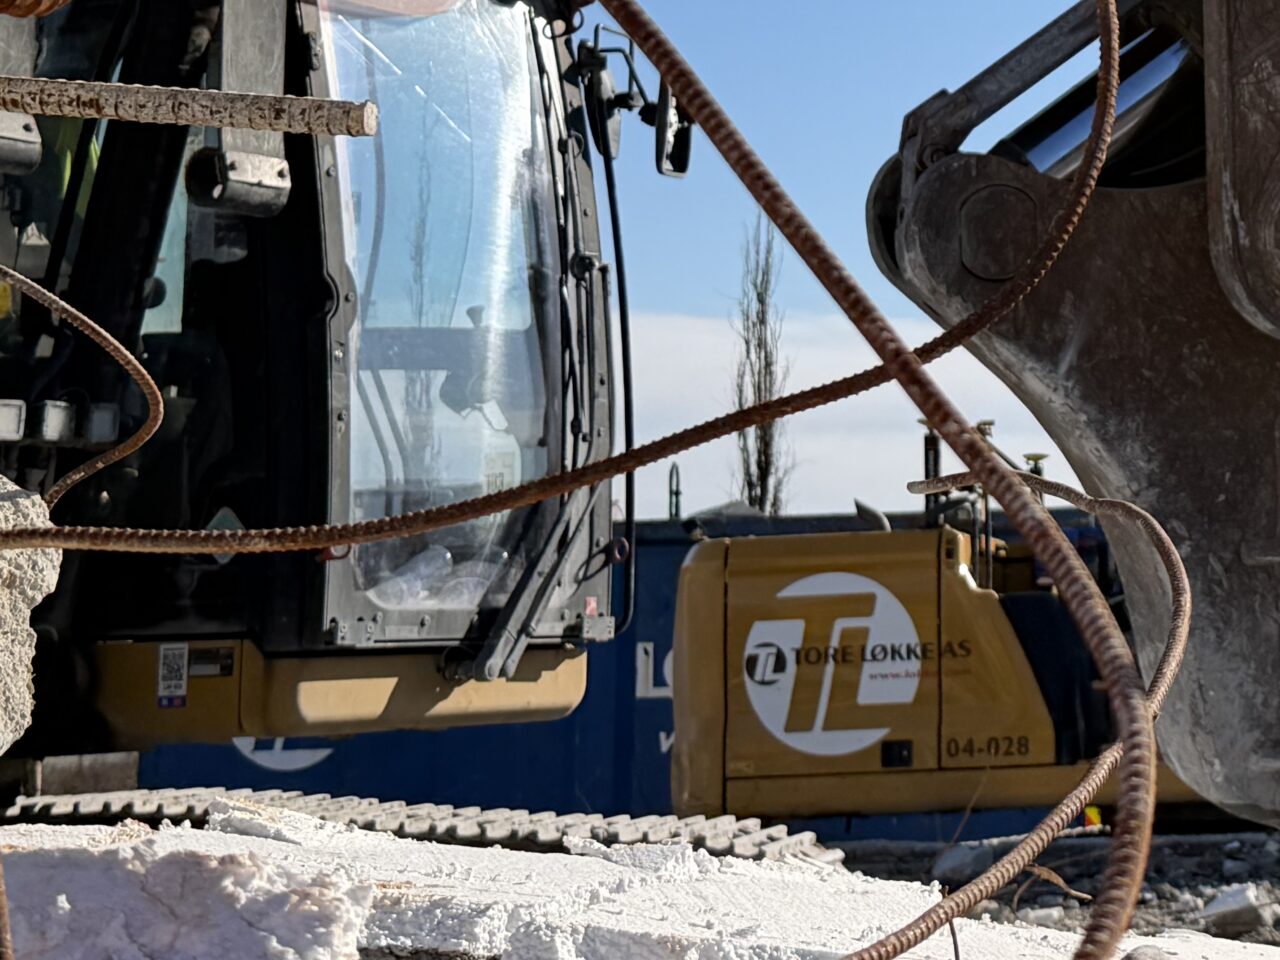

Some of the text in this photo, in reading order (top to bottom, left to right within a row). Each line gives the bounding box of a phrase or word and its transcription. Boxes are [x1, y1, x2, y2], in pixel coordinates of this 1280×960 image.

[791, 640, 972, 666] TORE LØKKE AS
[946, 736, 1030, 758] 04-028
